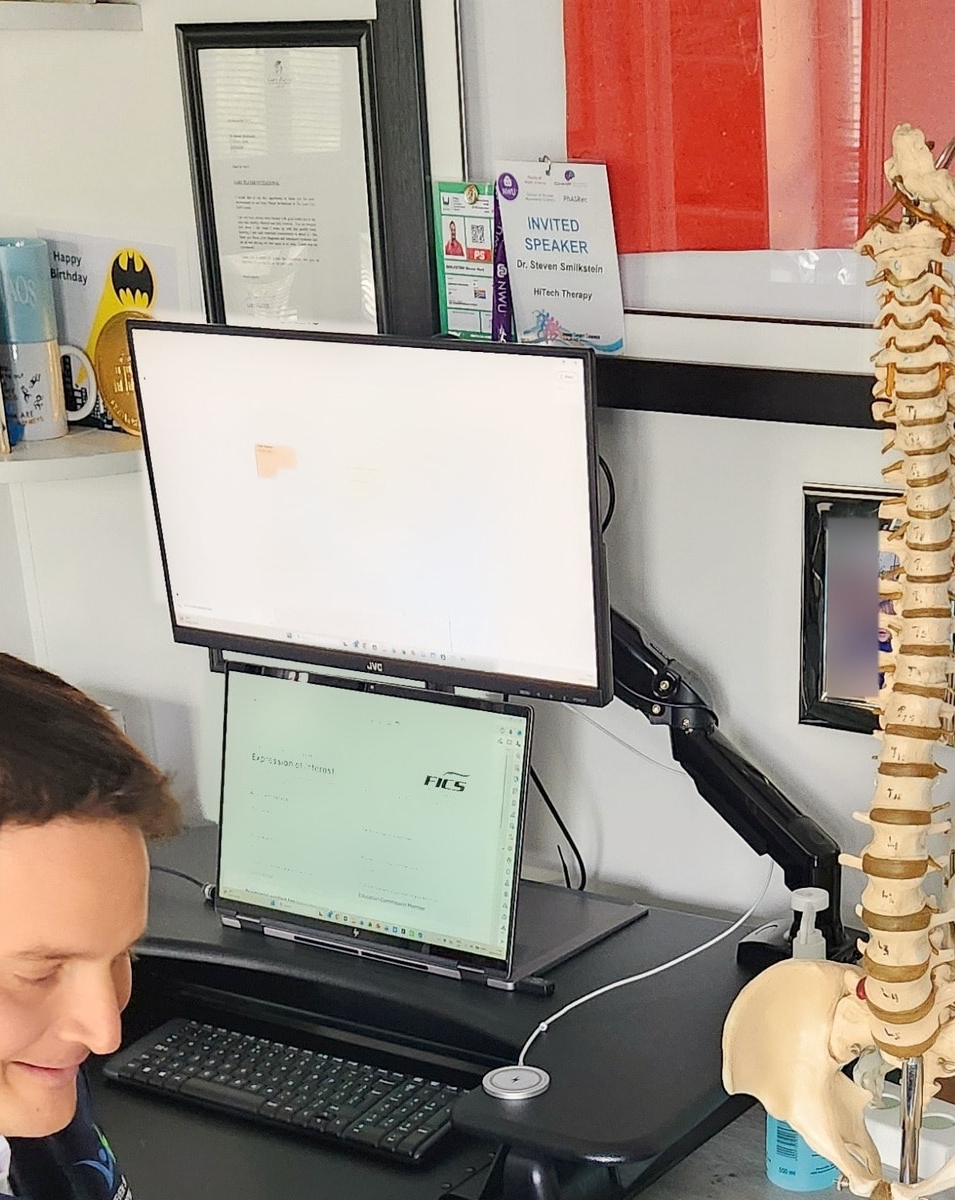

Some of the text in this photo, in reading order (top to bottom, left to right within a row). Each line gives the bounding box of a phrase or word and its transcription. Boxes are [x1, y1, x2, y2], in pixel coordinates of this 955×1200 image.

[527, 216, 580, 232] INVITED
[524, 237, 589, 255] SPEAKER
[53, 250, 82, 267] Happy
[473, 250, 486, 260] PS
[516, 259, 604, 273] Dr. Steven Smilkstein
[49, 267, 88, 285] Birthday
[533, 288, 593, 301] HiTech Therapy
[366, 661, 384, 672] JVC
[423, 774, 468, 792] FICS
